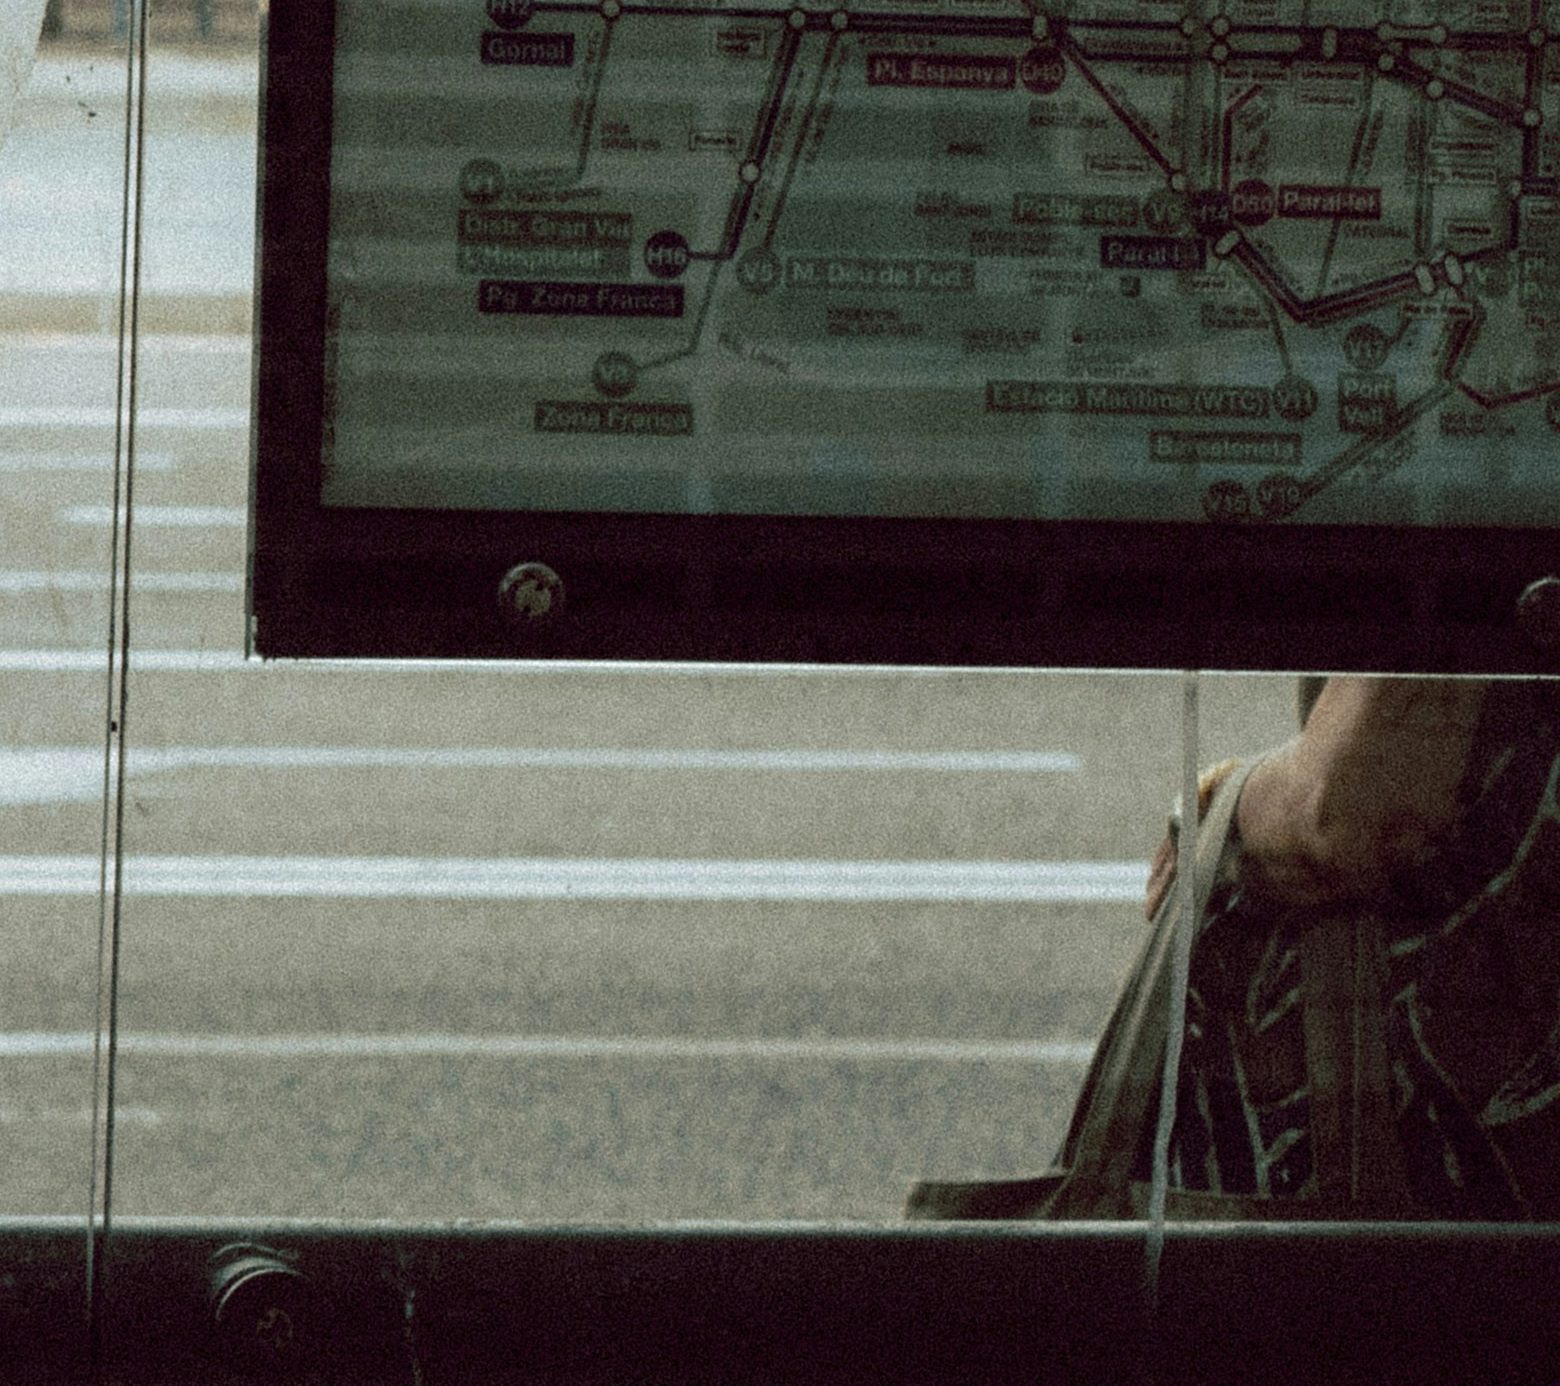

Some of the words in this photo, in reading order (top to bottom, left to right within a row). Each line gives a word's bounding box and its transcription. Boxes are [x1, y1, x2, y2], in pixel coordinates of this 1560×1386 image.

[487, 39, 567, 61] Gornal
[873, 60, 903, 81] Pl.
[910, 61, 1009, 86] Espanya
[1021, 64, 1064, 83] D40
[1233, 194, 1274, 212] D50
[463, 214, 520, 238] Distr.
[531, 215, 589, 238] Gran
[594, 217, 630, 240] Via
[645, 245, 688, 268] H16
[792, 263, 818, 283] M.
[485, 285, 517, 311] Pg.
[531, 287, 589, 308] Zona
[595, 289, 677, 312] Franca
[992, 387, 1077, 409] Estació
[1194, 390, 1265, 413] (WTC)
[1343, 379, 1392, 398] Port
[540, 407, 600, 429] Zona
[607, 409, 688, 431] Franca
[1344, 403, 1381, 423] Vell
